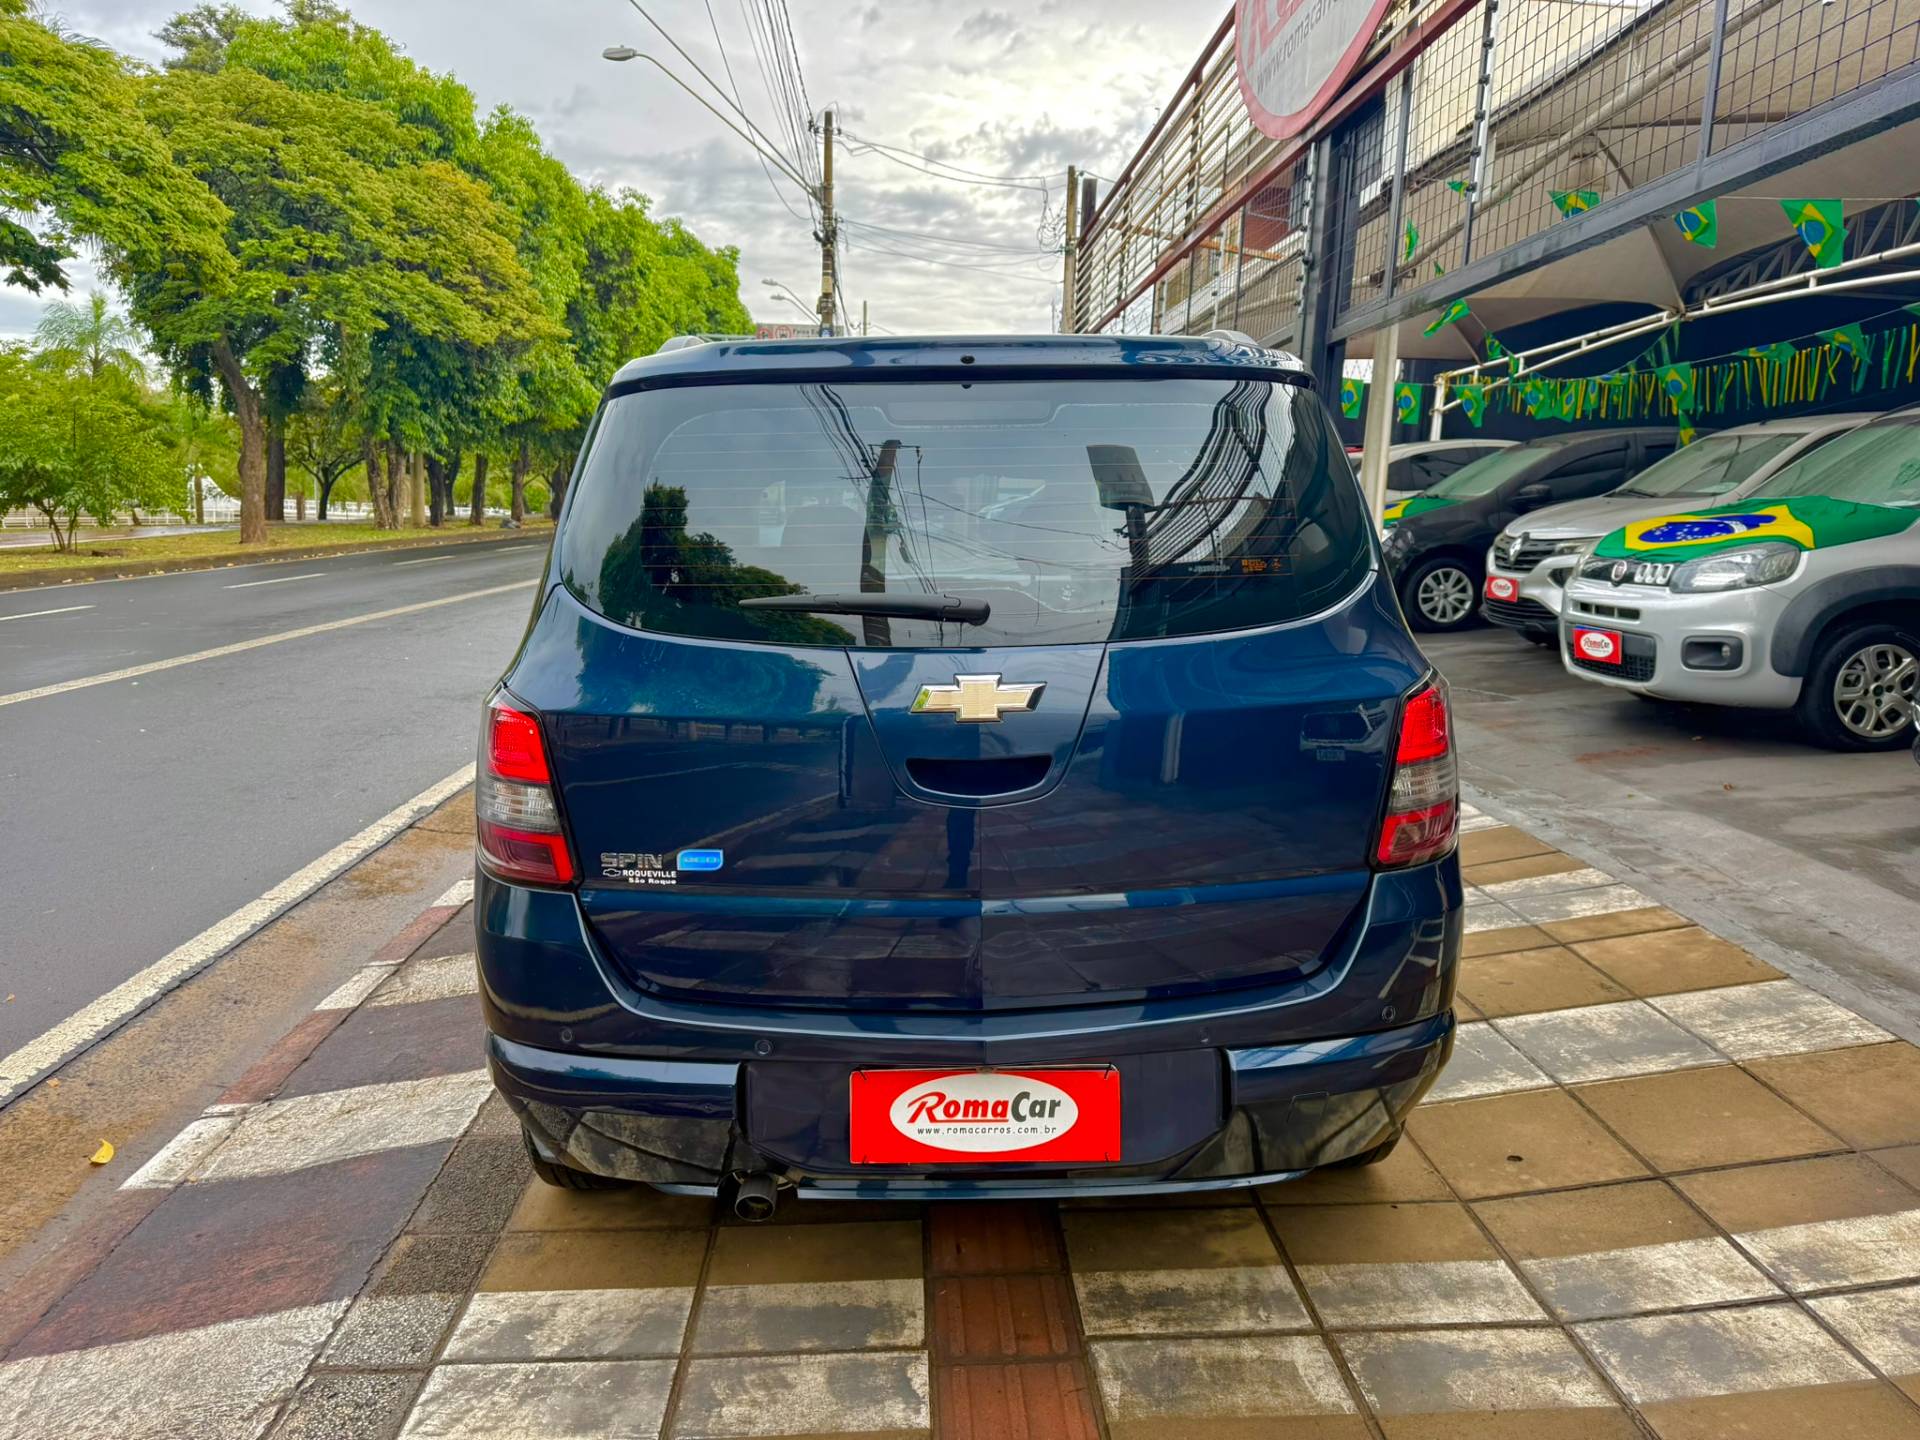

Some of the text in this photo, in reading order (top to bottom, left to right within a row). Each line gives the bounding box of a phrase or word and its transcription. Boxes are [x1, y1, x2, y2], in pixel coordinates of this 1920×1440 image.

[600, 852, 662, 869] SPIN
[622, 869, 677, 878] ROQUEVILLE
[907, 1091, 1061, 1123] RomaCar
[917, 1126, 1057, 1135] www.romacarros.com.br
